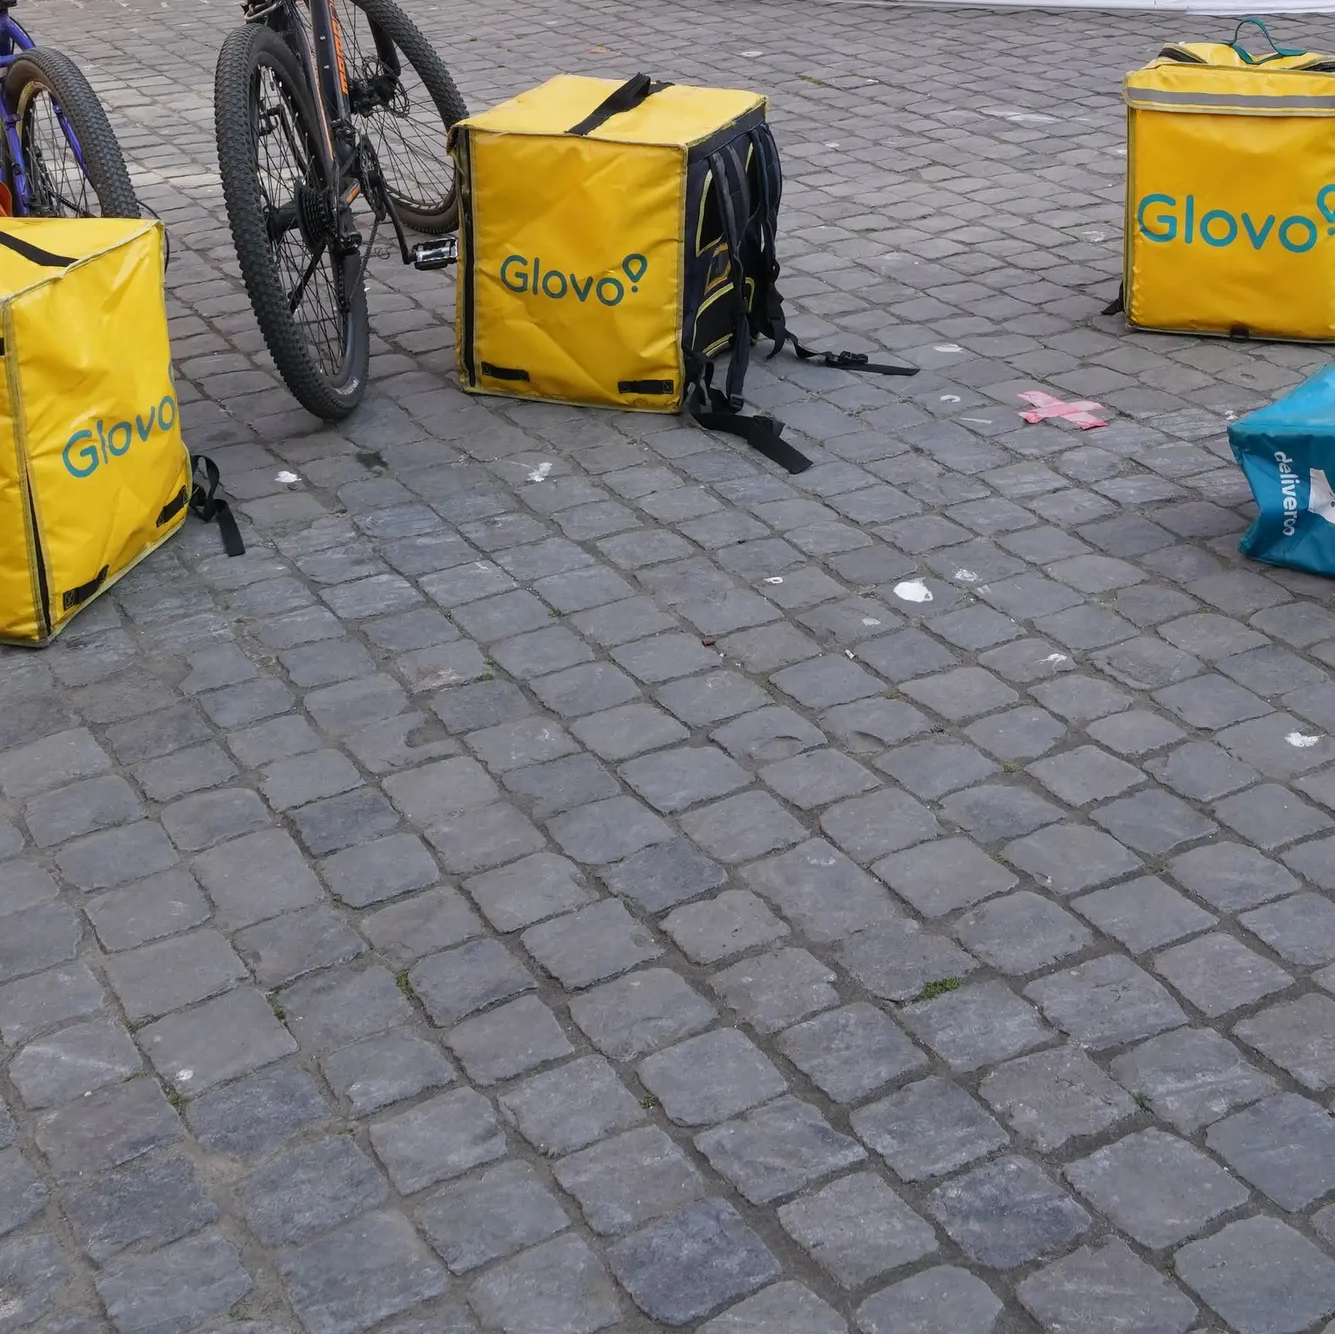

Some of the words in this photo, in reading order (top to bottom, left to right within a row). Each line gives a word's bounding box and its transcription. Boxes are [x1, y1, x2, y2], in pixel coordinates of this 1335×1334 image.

[1137, 193, 1318, 253] Glovo
[500, 254, 624, 307] Glovo
[62, 395, 175, 478] Glovo
[1273, 451, 1300, 536] deliveroo
